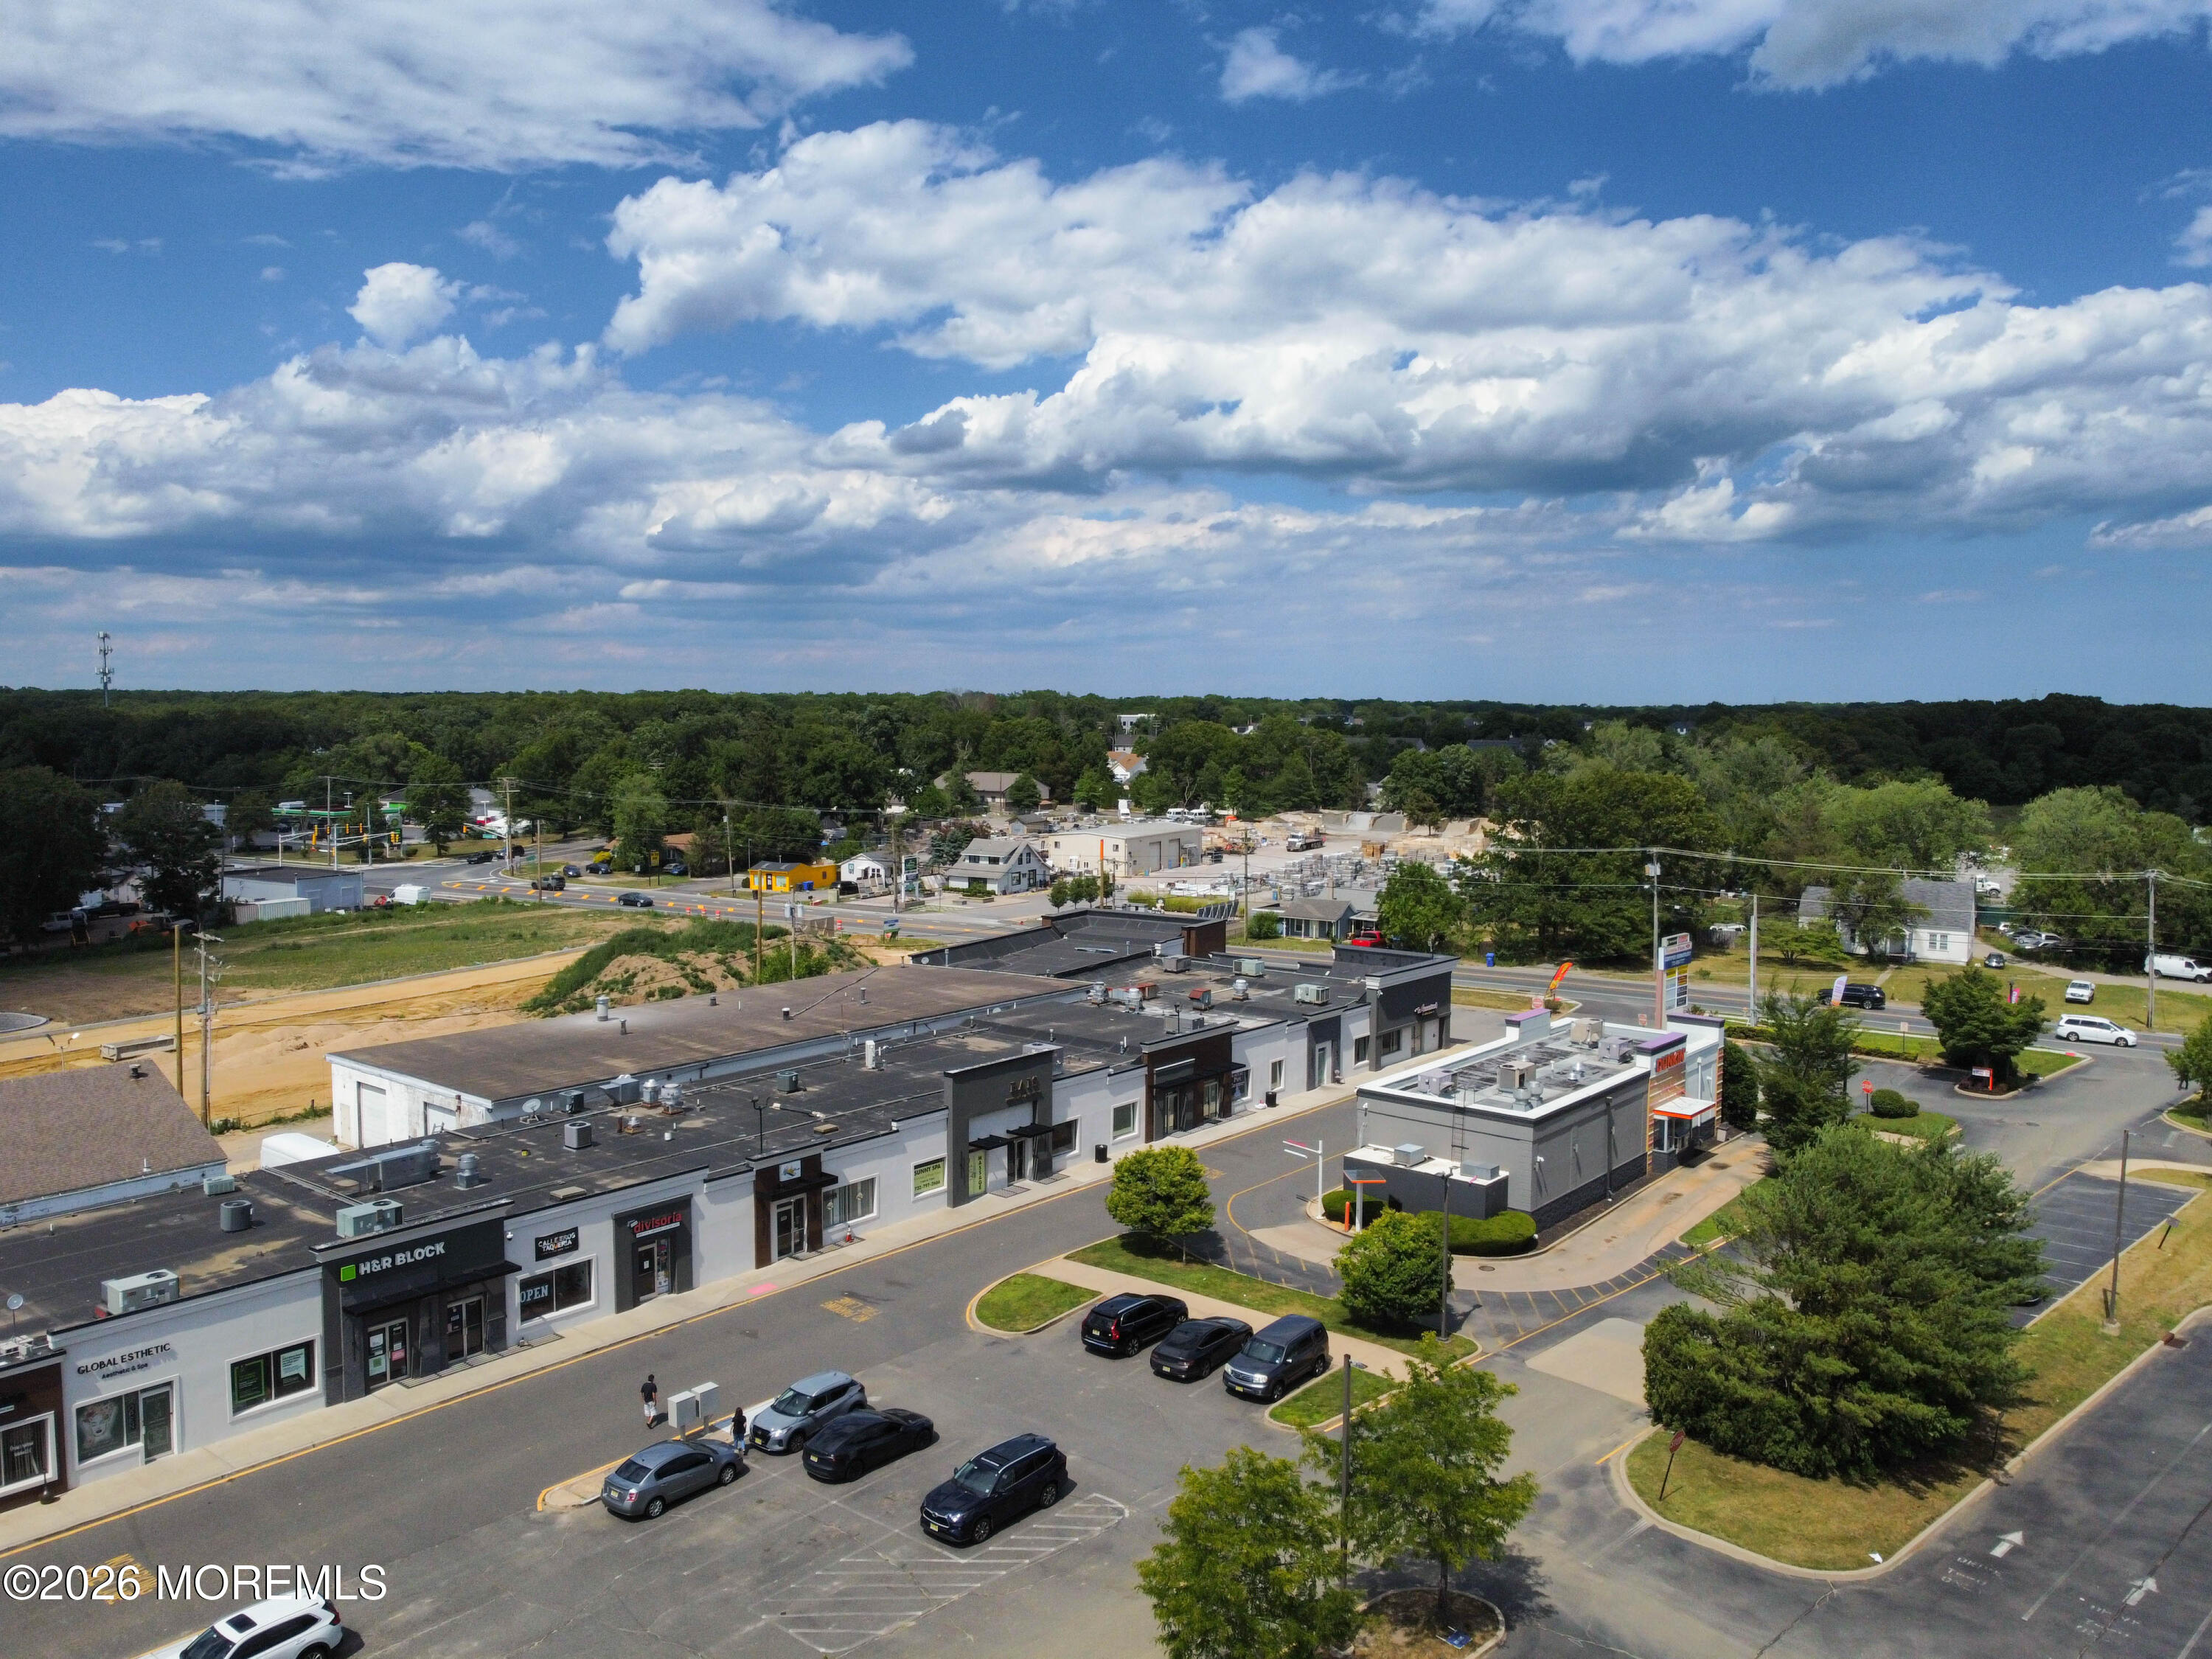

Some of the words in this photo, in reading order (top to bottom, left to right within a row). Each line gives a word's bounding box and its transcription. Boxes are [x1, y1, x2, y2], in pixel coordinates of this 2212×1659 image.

[914, 1166, 931, 1176] SUNNY
[634, 1211, 682, 1233] divisoria
[538, 1232, 576, 1247] CALLEEROS
[358, 1256, 392, 1276] H&R
[394, 1242, 446, 1266] BLOCK
[521, 1284, 549, 1303] OPEN
[77, 1357, 119, 1375] GLOBAL
[120, 1343, 171, 1363] ESTHETIC
[102, 1367, 131, 1380] Aesthetic
[137, 1363, 148, 1371] Spa
